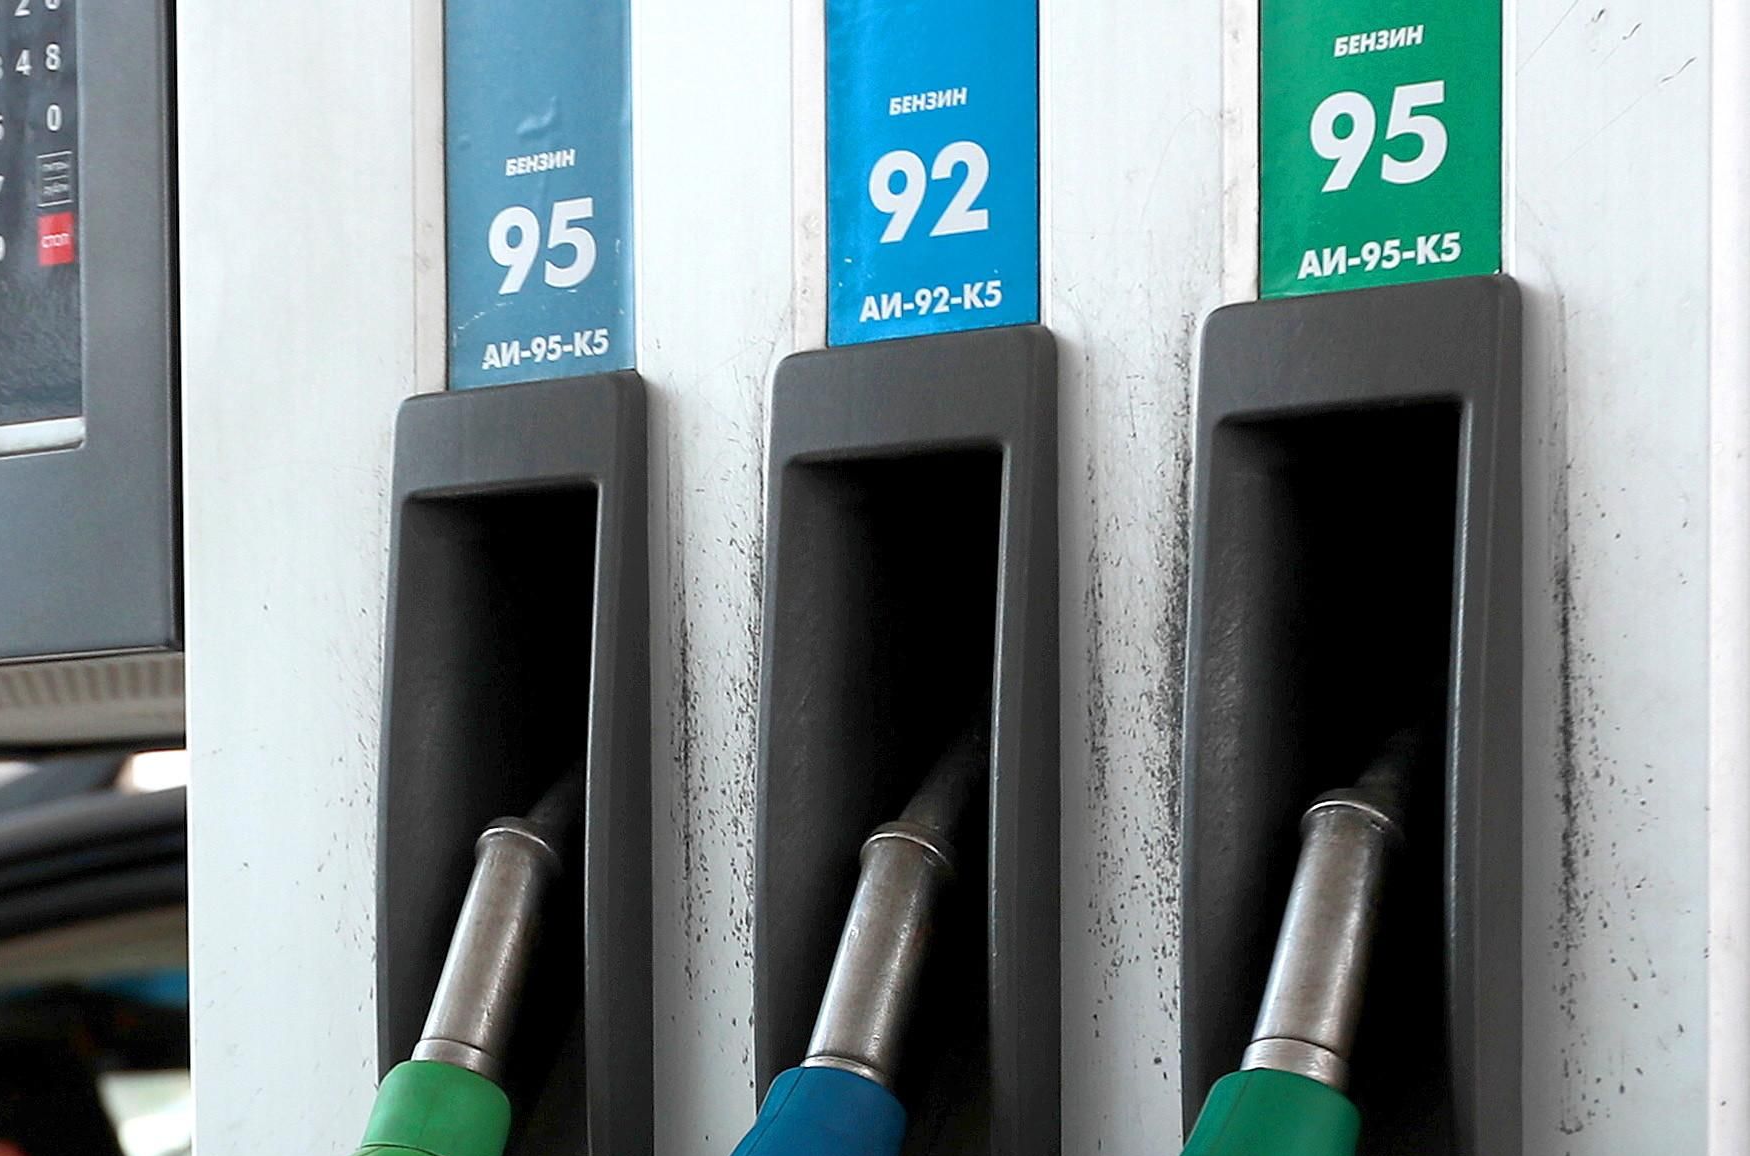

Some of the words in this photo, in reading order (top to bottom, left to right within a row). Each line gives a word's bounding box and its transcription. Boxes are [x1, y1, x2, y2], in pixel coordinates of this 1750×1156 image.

[15, 49, 32, 76] 4
[45, 43, 61, 71] 8
[1333, 24, 1425, 58] БЕНЗИН
[46, 104, 62, 131] 0
[888, 87, 968, 116] БЕНЗИН
[1310, 80, 1449, 193] 95
[505, 149, 576, 177] БЕНЗИН
[868, 140, 990, 244] 92
[488, 197, 597, 295] 95
[1297, 232, 1462, 280] АИ-95-К5
[858, 280, 1002, 323] АИ-92-К5
[481, 328, 610, 370] АИ-95-К5
